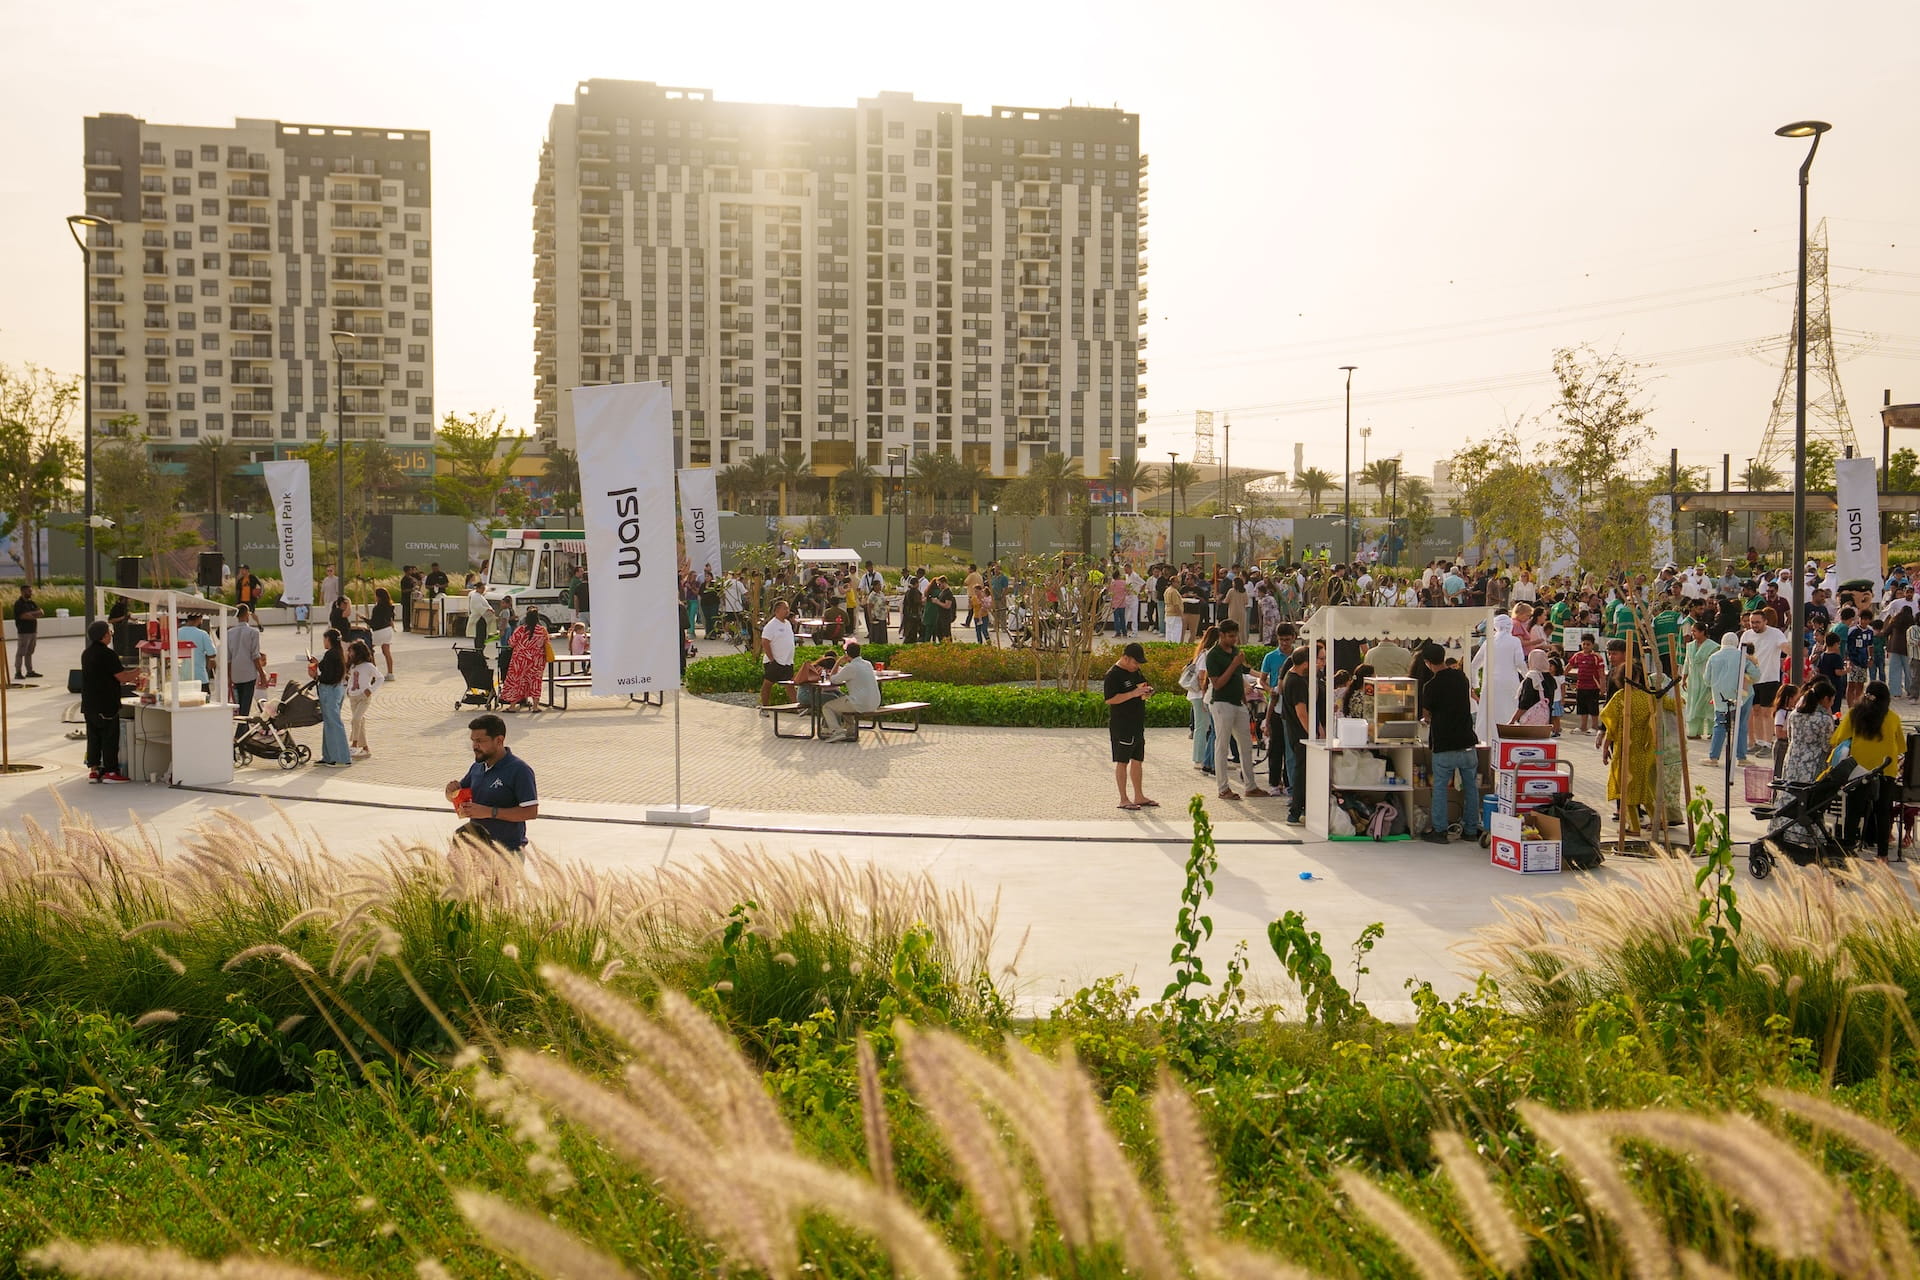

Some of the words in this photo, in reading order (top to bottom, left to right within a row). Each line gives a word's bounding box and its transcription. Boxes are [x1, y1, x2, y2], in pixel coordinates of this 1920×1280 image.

[282, 491, 292, 519] Park
[607, 487, 641, 580] wasl
[690, 507, 706, 543] wasl
[1846, 508, 1862, 552] wasl
[282, 523, 294, 568] Central
[405, 542, 438, 550] CENTRAL
[440, 542, 460, 550] PARK
[617, 675, 652, 686] wasl.ae
